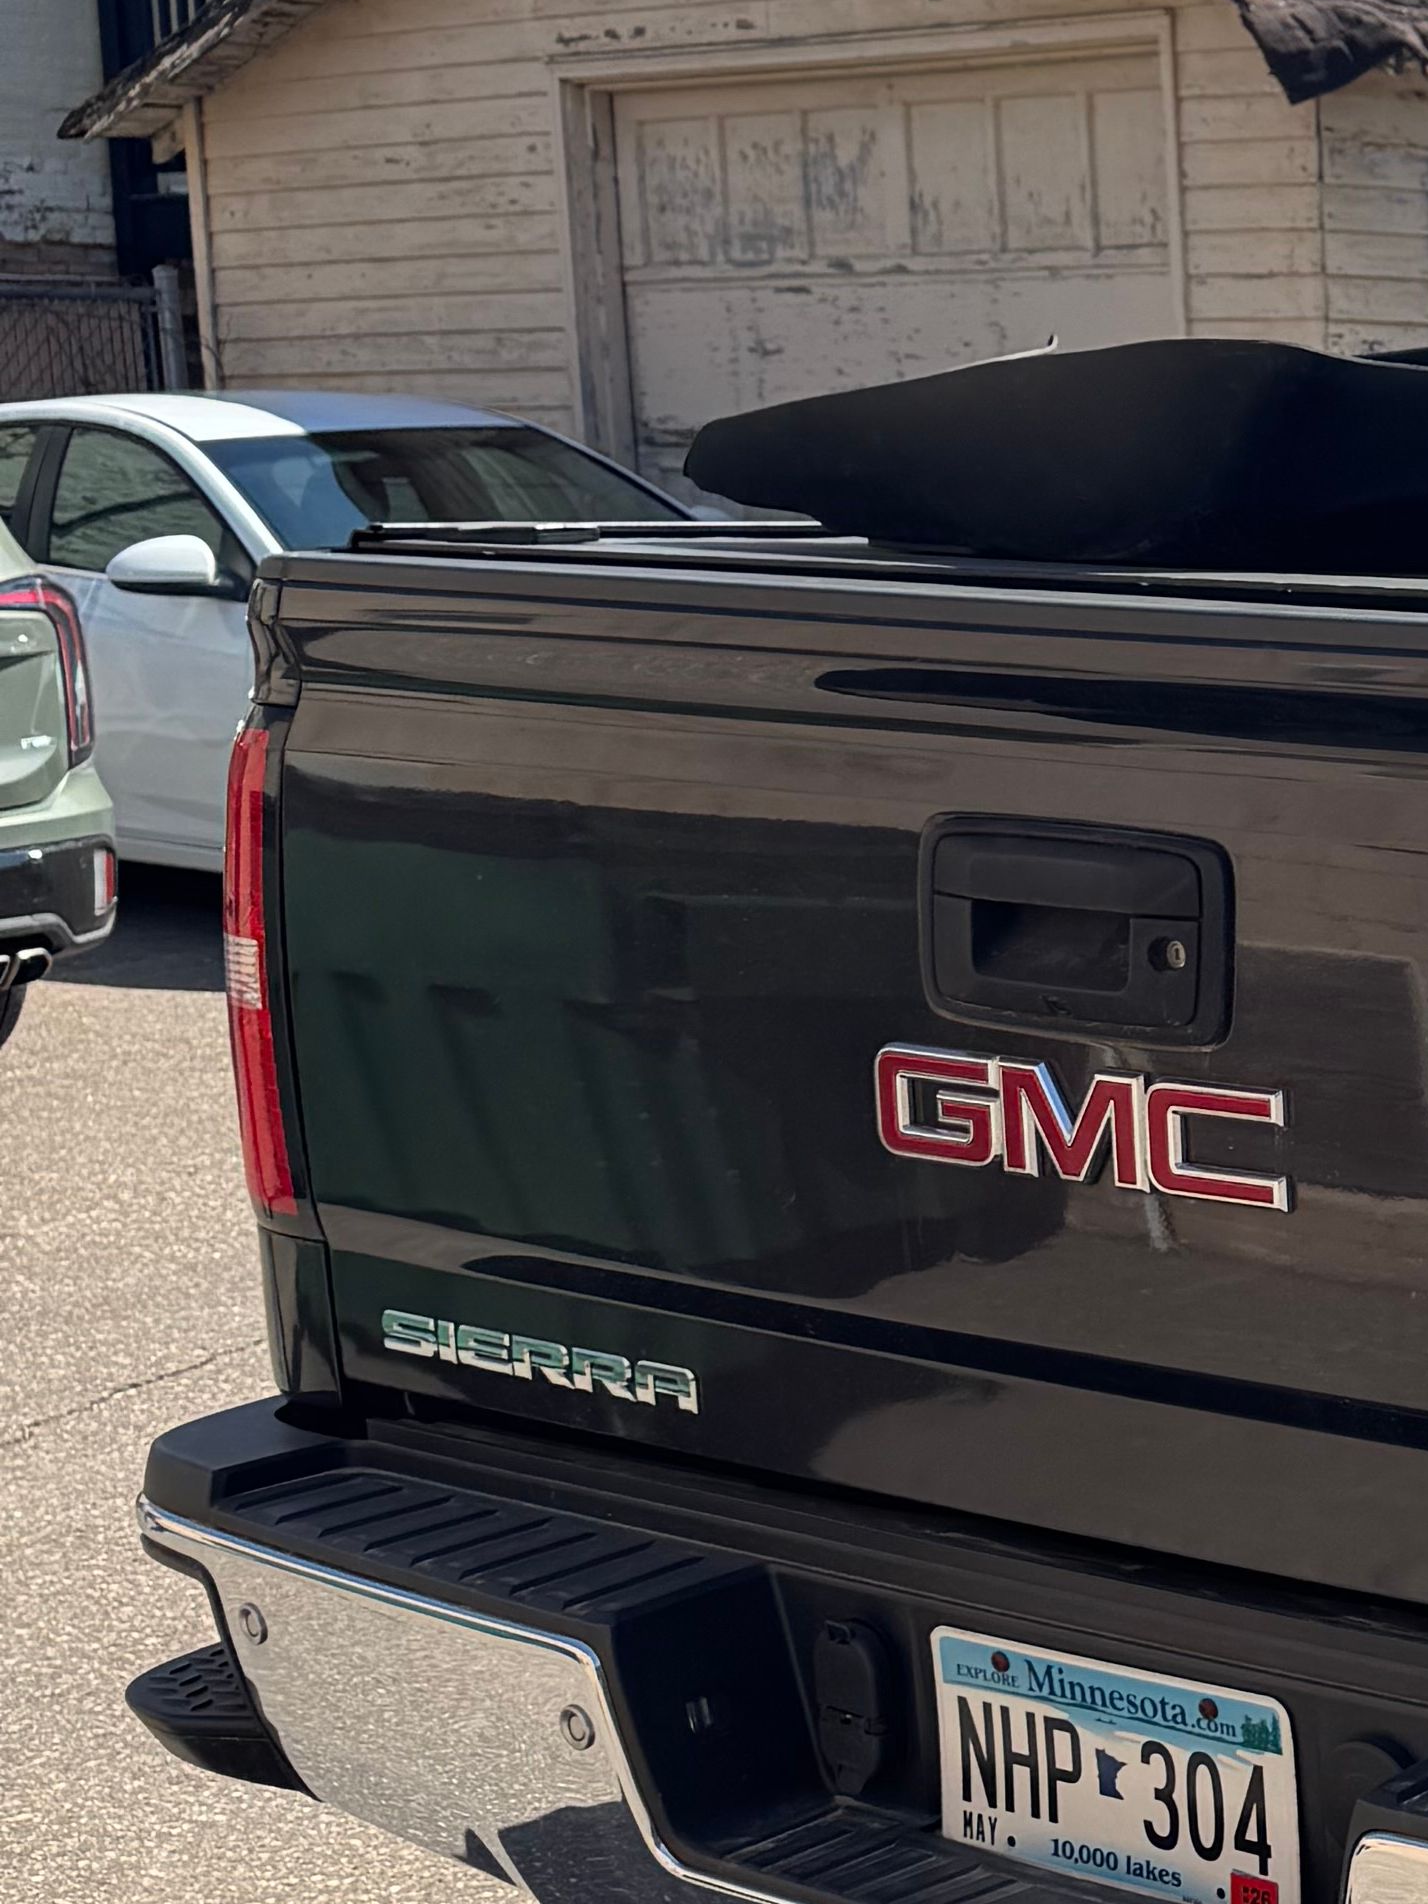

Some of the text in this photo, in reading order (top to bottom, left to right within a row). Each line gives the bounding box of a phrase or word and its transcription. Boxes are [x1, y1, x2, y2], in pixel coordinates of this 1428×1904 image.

[874, 1041, 1294, 1214] GMC
[381, 1309, 700, 1415] SIERRA
[956, 1662, 1020, 1689] EXPLORE
[957, 1696, 1272, 1876] NHP 304
[963, 1810, 998, 1846] MAY
[1051, 1838, 1182, 1888] 10,000 lakes
